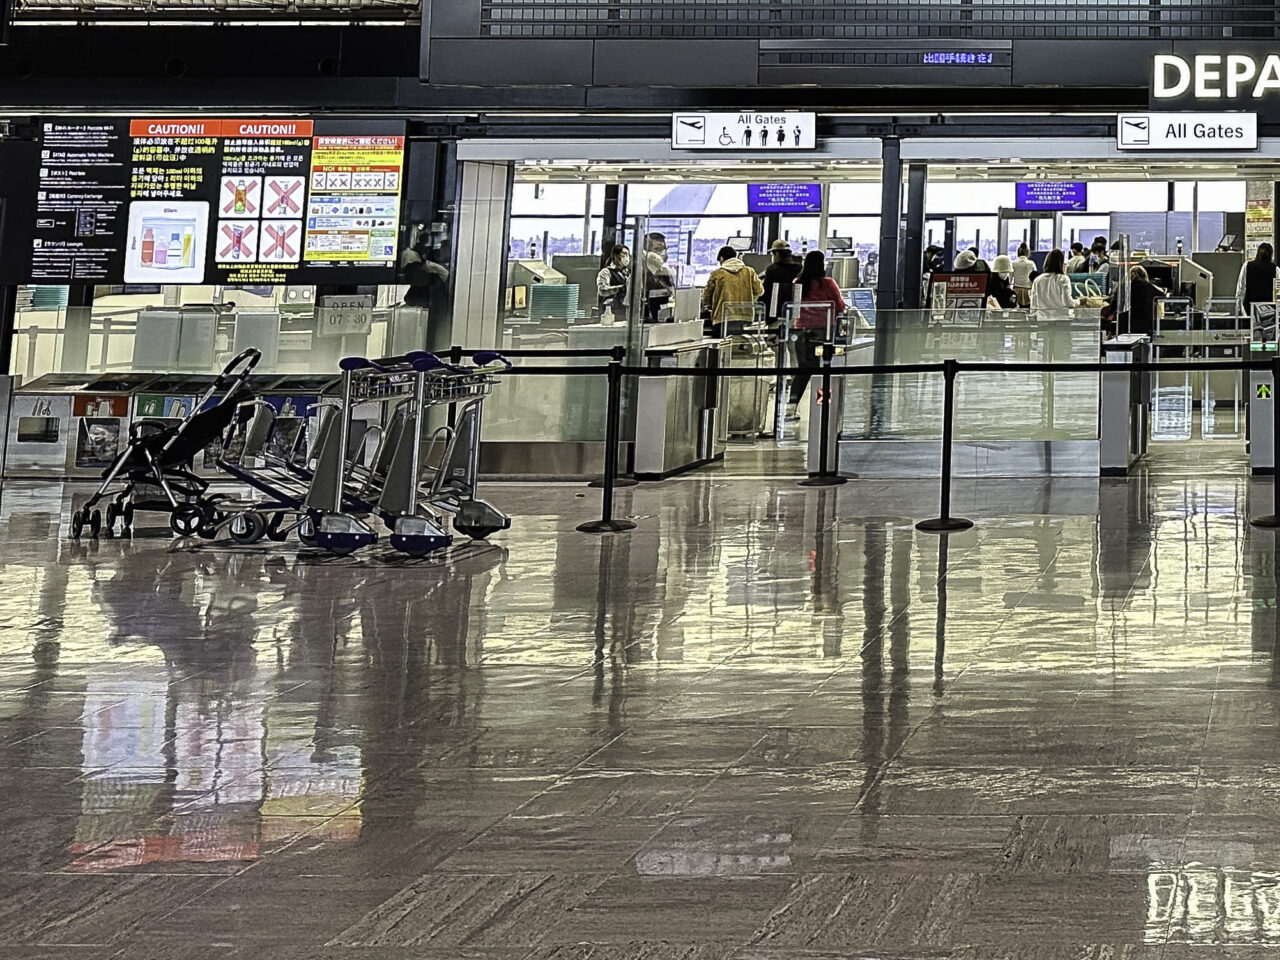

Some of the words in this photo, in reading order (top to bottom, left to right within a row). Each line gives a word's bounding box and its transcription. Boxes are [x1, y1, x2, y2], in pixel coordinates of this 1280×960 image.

[738, 114, 751, 124] All
[754, 114, 786, 124] Gates
[148, 125, 204, 134] CAUTION!!
[240, 125, 296, 134] CAUTION!!
[1166, 124, 1192, 138] All
[1194, 124, 1243, 139] Gates
[333, 302, 364, 310] OPEN
